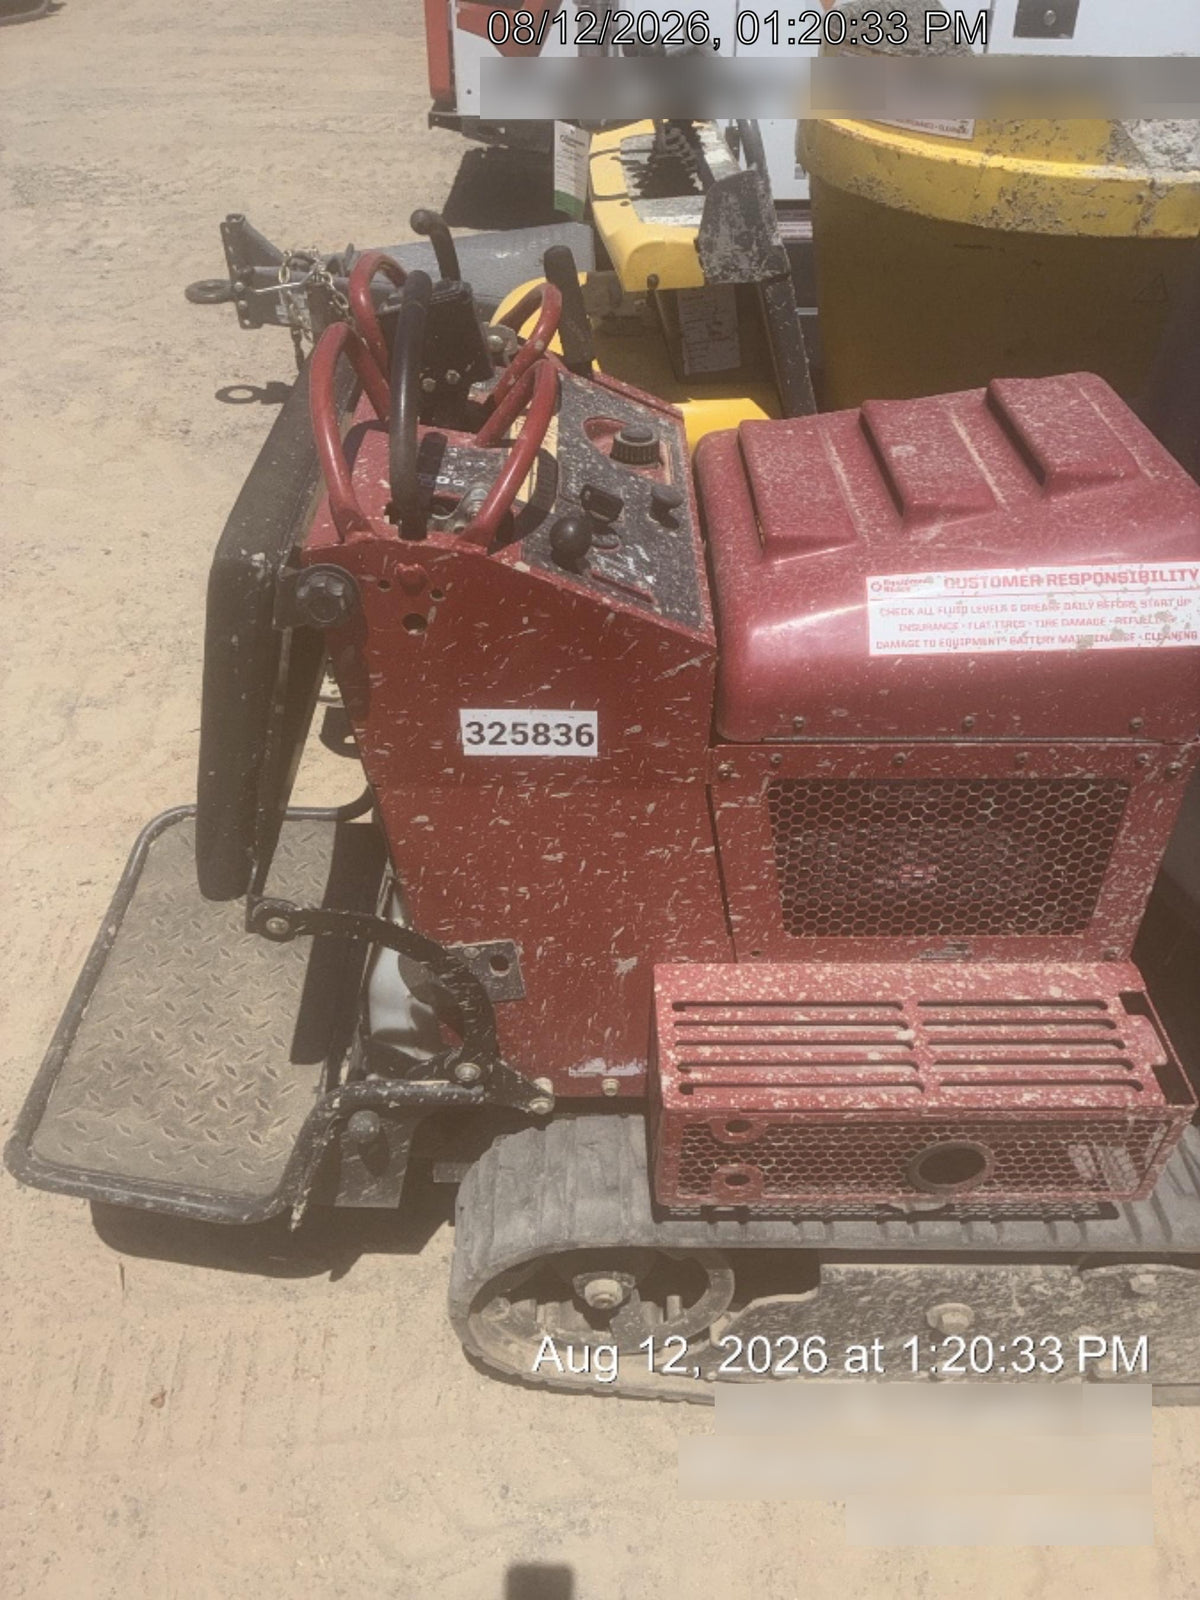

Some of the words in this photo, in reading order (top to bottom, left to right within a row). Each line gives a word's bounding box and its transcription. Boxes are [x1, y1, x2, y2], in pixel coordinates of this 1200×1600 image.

[944, 575, 1042, 589] CUSTOMER
[1047, 568, 1199, 586] RESPONSIBILITY
[879, 607, 915, 617] CHECK
[917, 607, 934, 616] ALL
[938, 605, 968, 615] FLUID
[1063, 601, 1094, 611] DAILY
[1140, 598, 1173, 608] START
[898, 621, 959, 632] INSURANCE
[1061, 617, 1106, 627] DAMAGE
[876, 639, 921, 650] DAMAGE
[923, 639, 936, 649] TO
[465, 721, 594, 747] 325836
